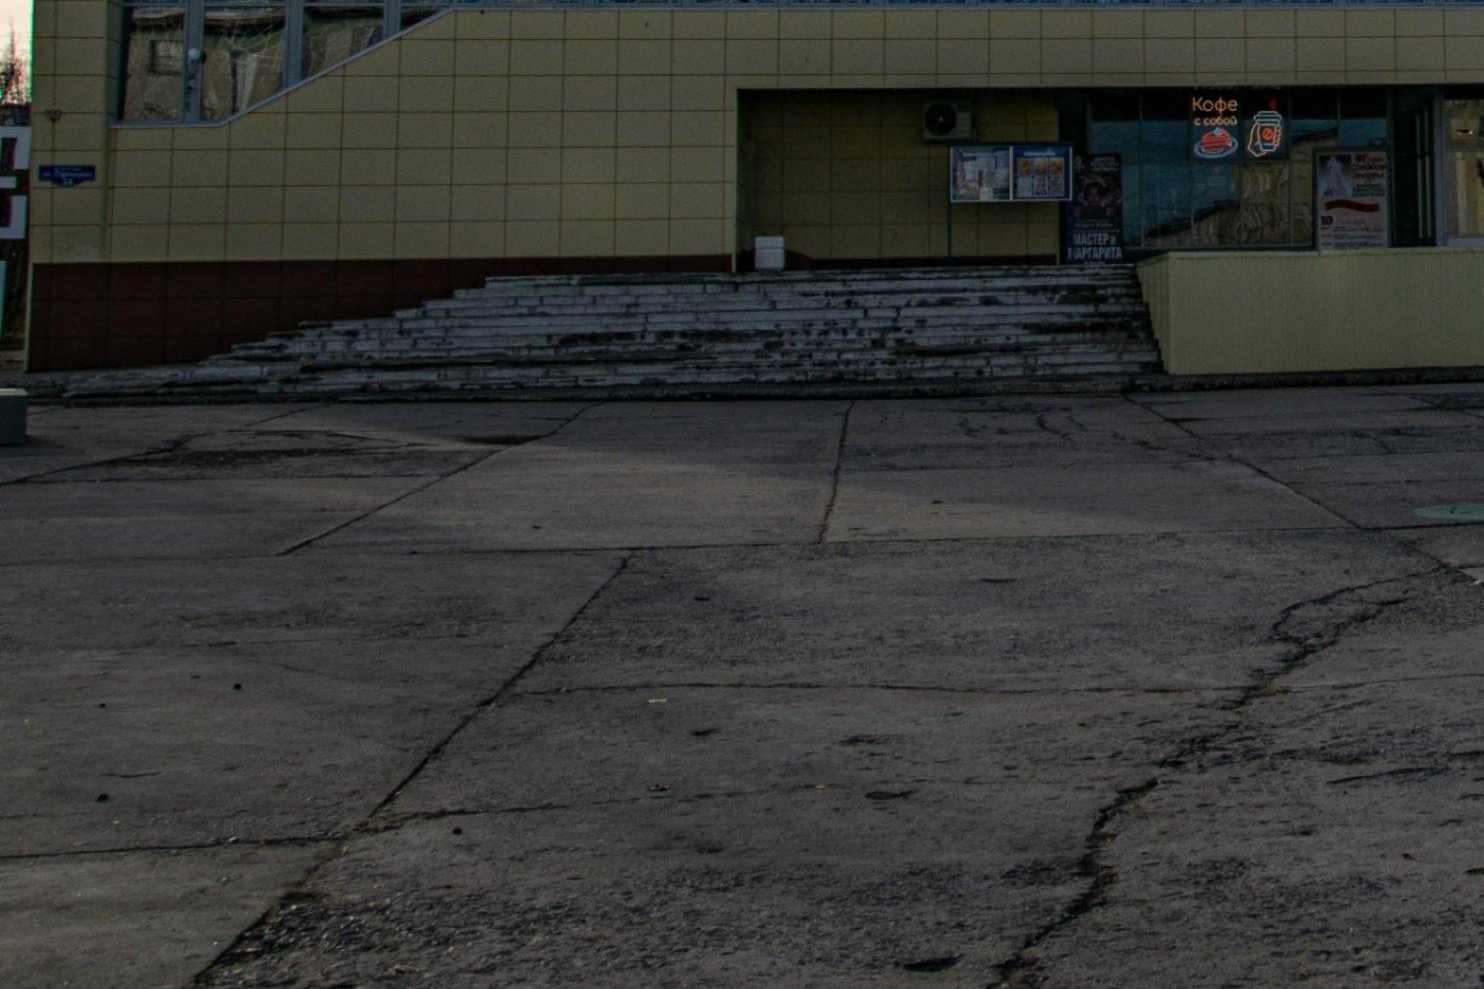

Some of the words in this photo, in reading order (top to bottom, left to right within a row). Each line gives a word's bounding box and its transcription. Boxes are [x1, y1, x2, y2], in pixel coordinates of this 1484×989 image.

[1192, 97, 1238, 116] Кофе
[1194, 117, 1201, 126] с
[1203, 116, 1238, 126] собой
[1073, 233, 1109, 246] МАСТЕР
